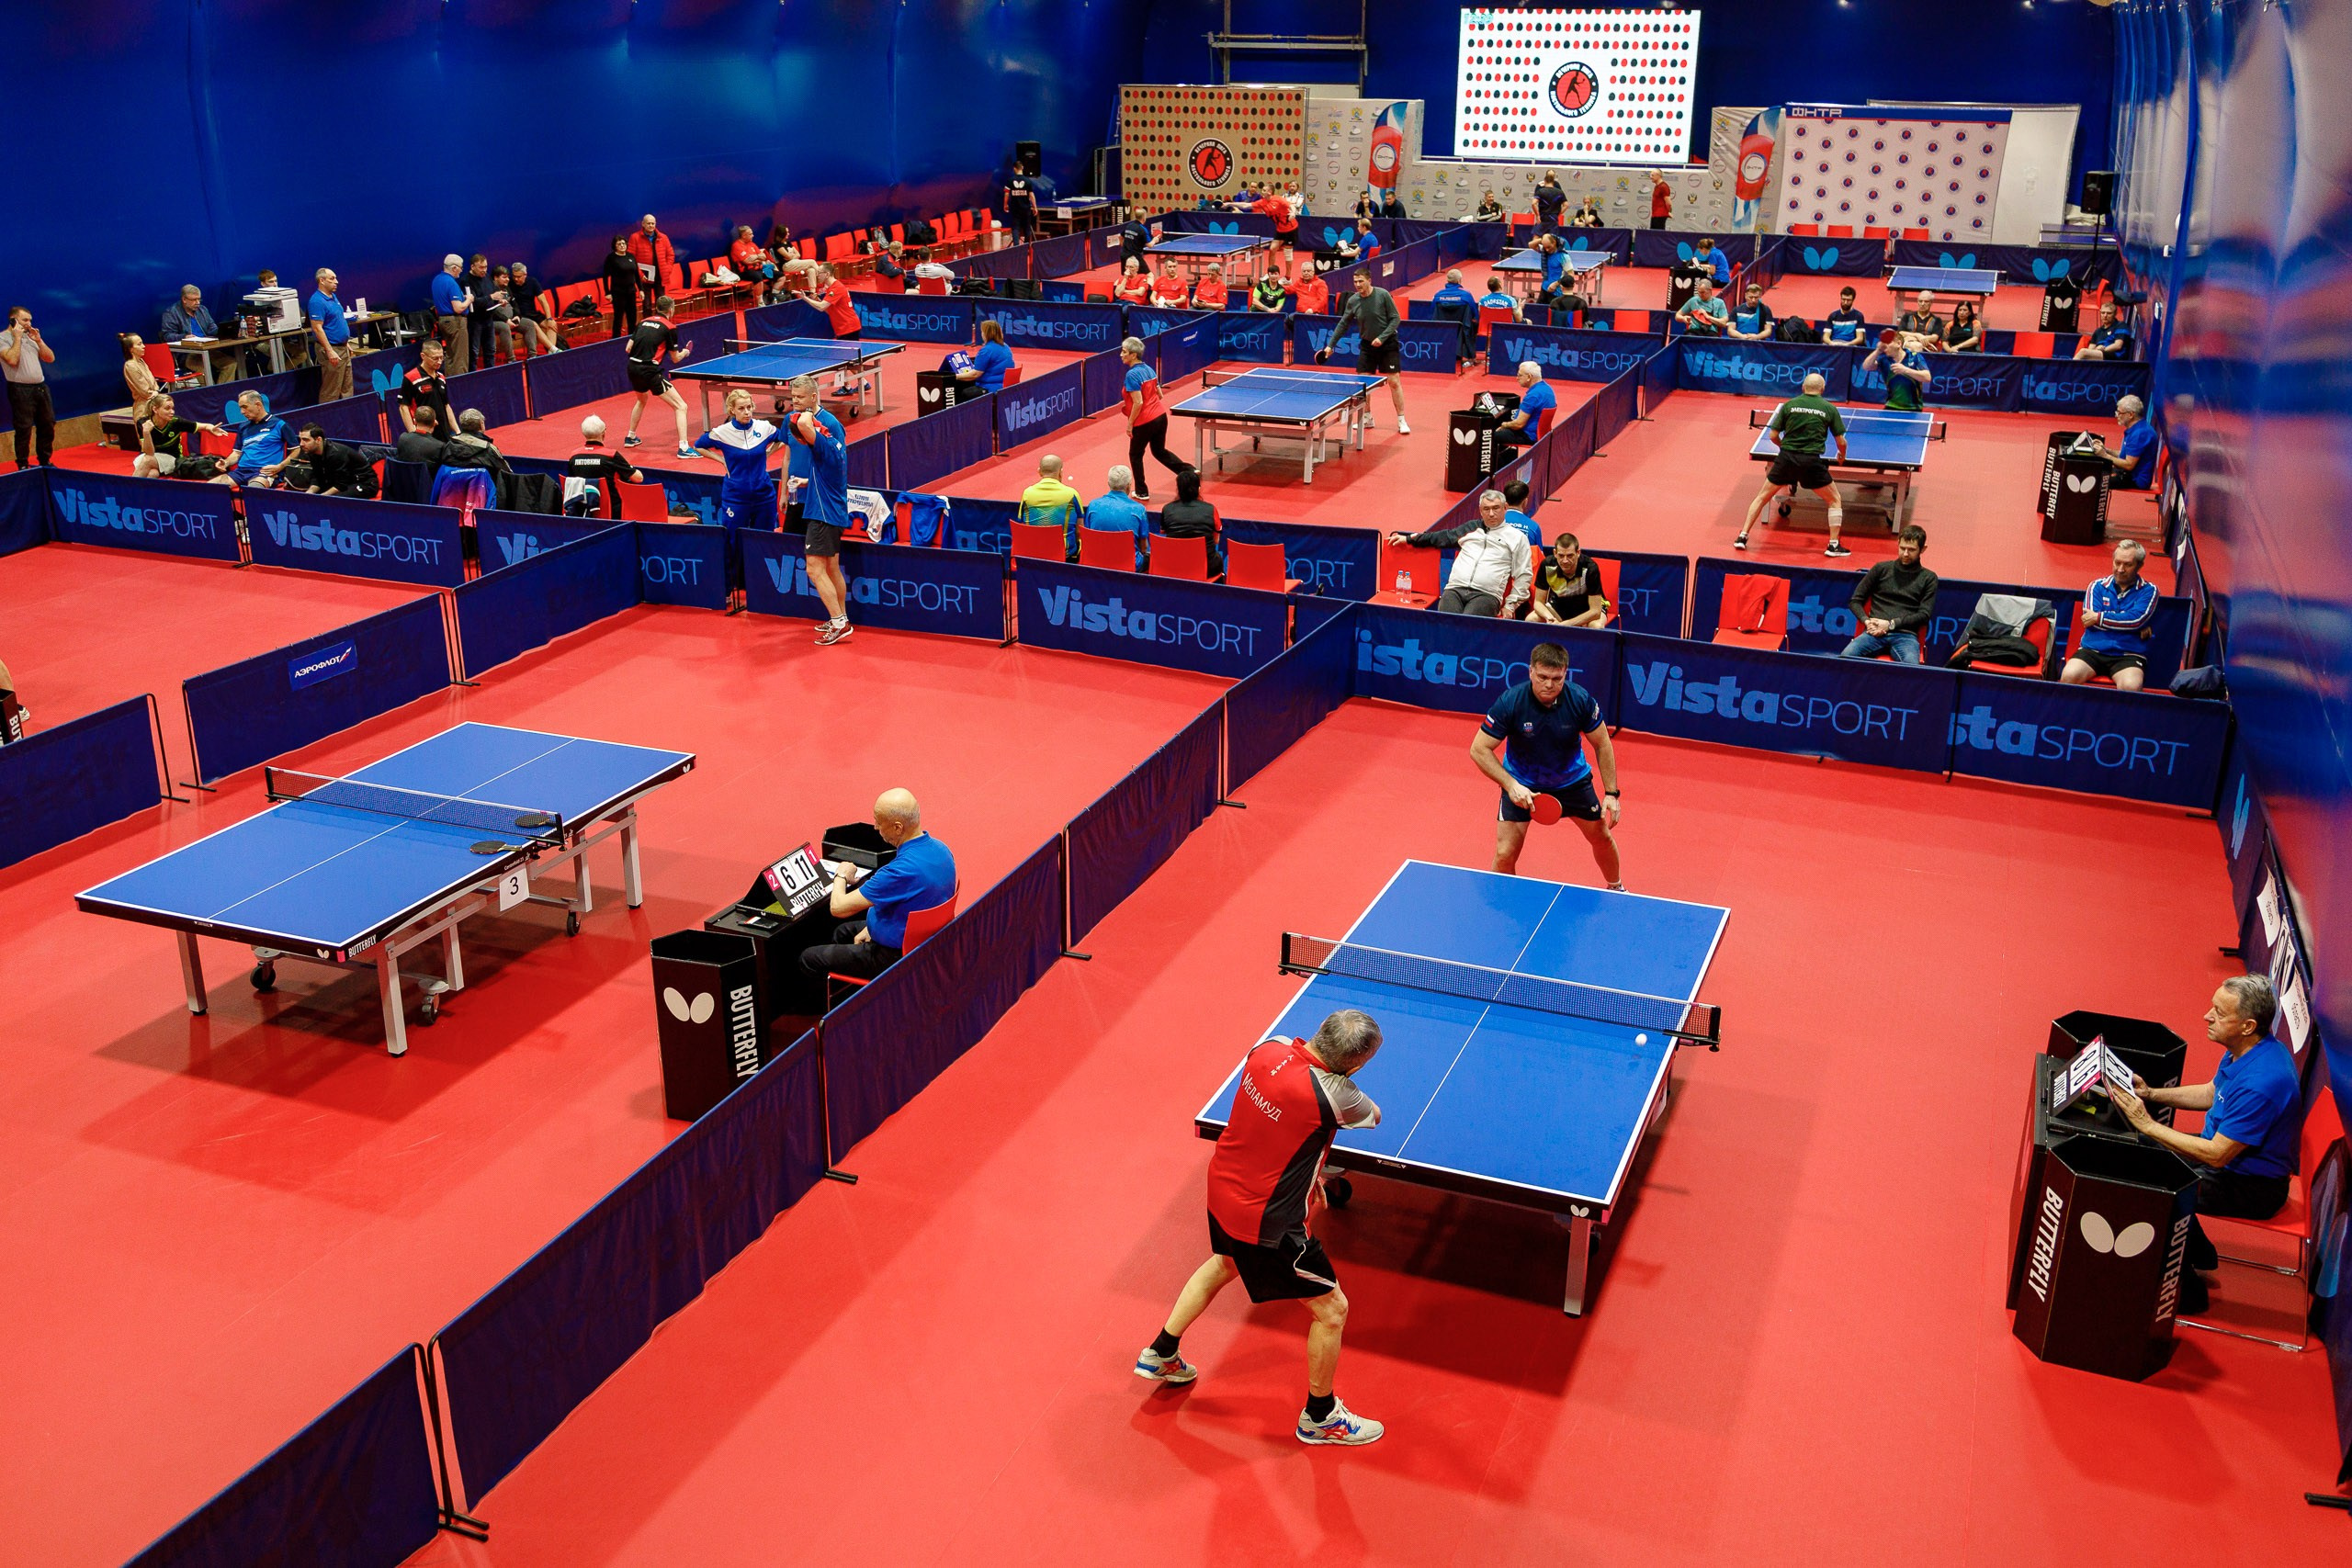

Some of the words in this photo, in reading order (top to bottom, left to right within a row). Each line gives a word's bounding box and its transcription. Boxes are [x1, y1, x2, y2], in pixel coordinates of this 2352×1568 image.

[1219, 333, 1271, 351] PORT
[1004, 387, 1076, 432] VistaSPORT
[1480, 429, 1492, 473] BUTTERFLY
[52, 488, 218, 539] VistaSPORT
[2046, 469, 2061, 520] BUTTERFLY
[262, 511, 443, 566] VistaSPORT
[1037, 585, 1261, 657] VistaSPORT
[294, 655, 341, 679] АЭРОФЛОТ
[1627, 660, 1918, 740] VistaSPORT
[509, 876, 519, 896] 3
[768, 874, 777, 888] 2
[780, 865, 797, 890] 6
[795, 854, 814, 881] 11
[808, 850, 818, 863] 1
[789, 880, 826, 908] BUTTERFLY
[348, 933, 377, 958] BUTTERFLY
[729, 984, 759, 1078] BUTTERFLY
[2028, 1186, 2064, 1303] BUTTERFLY
[2154, 1214, 2191, 1323] BUTTERFLY
